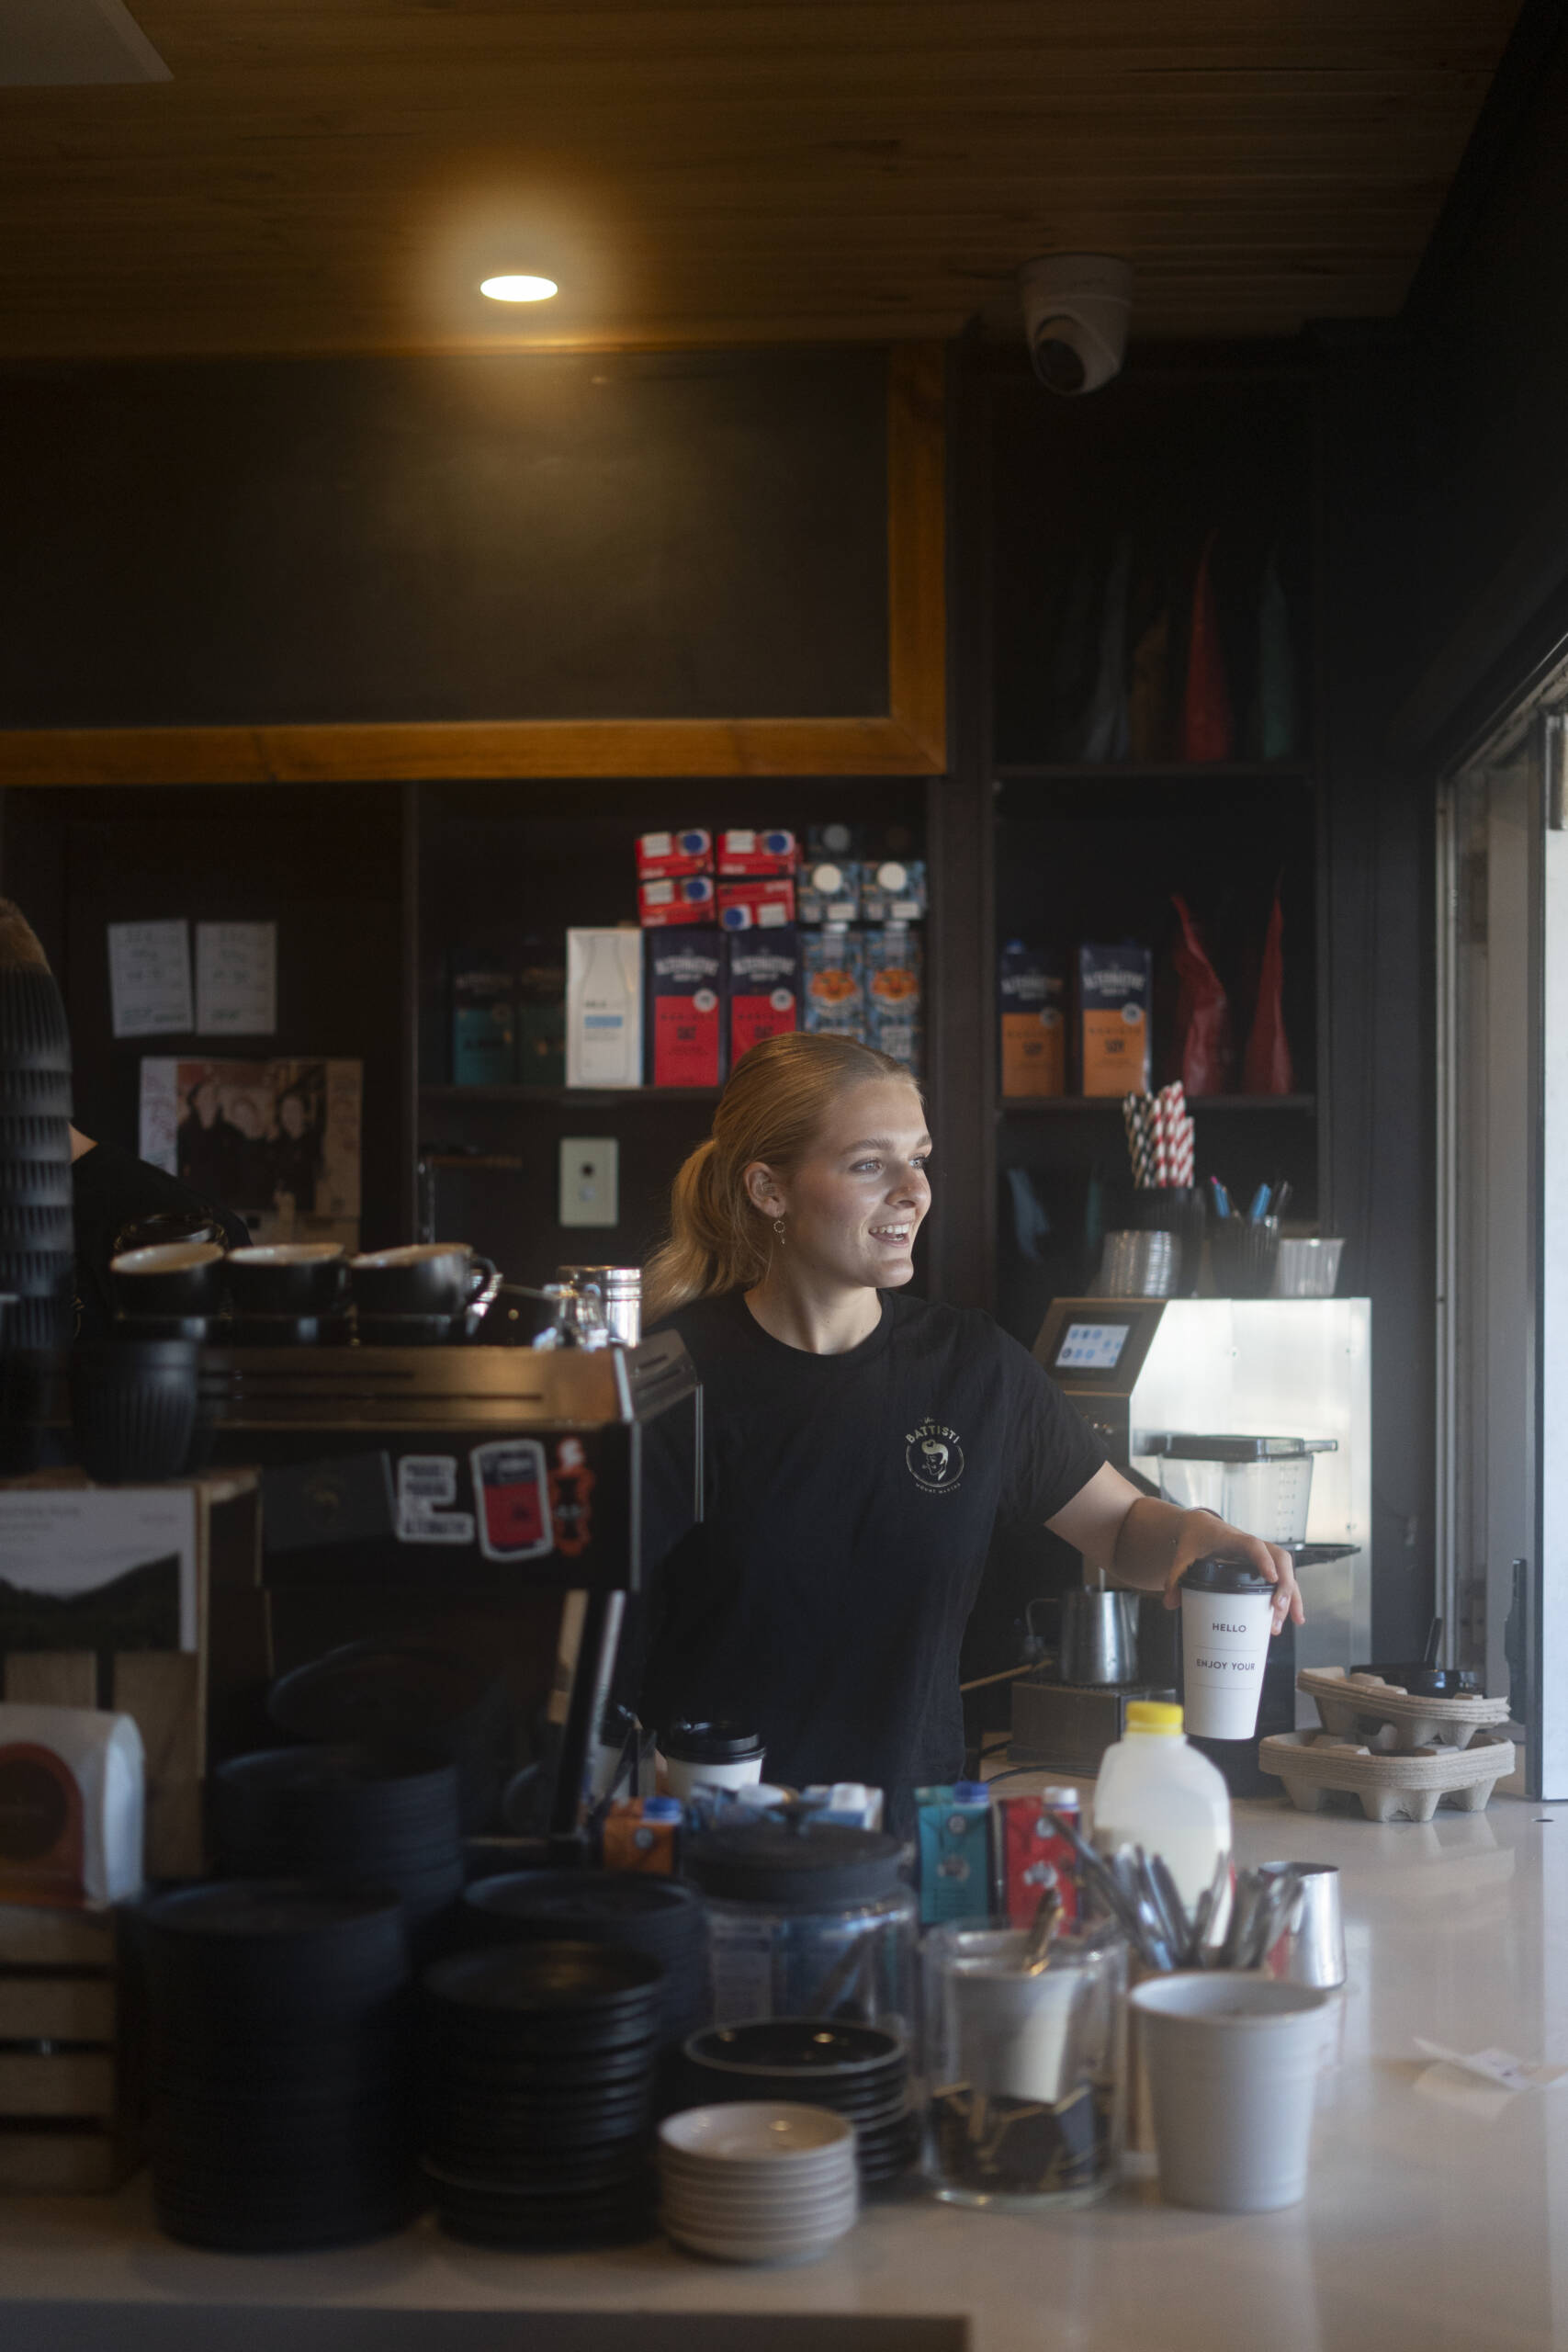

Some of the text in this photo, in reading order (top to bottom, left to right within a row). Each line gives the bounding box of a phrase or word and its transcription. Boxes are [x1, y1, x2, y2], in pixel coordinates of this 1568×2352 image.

[905, 1425, 961, 1444] BATTISTI
[1212, 1623, 1247, 1633] HELLO
[1196, 1658, 1256, 1670] ENJOY YOUR
